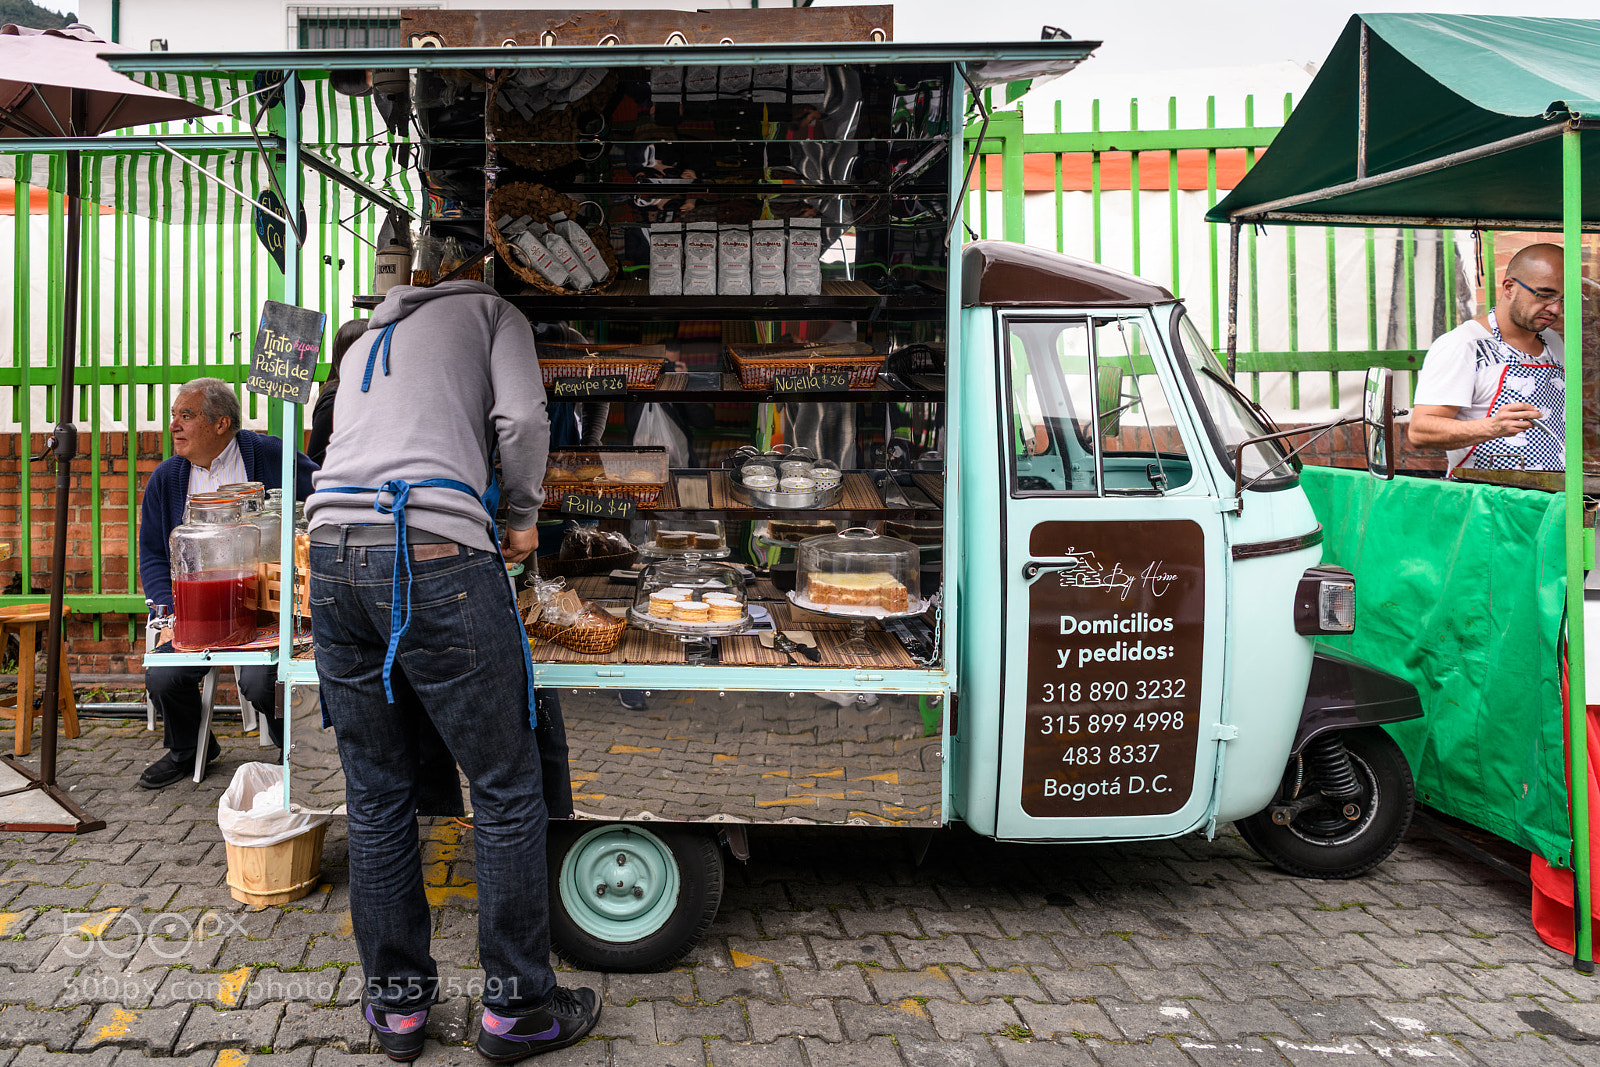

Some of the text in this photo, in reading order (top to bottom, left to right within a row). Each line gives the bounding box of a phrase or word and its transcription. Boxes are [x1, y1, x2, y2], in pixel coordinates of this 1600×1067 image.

[263, 329, 293, 353] Tinto
[255, 354, 309, 380] Pastel de
[246, 375, 300, 398] arequipe
[554, 380, 599, 396] Arequipe
[566, 495, 602, 514] Pollo
[1102, 560, 1179, 602] By Home
[1060, 612, 1174, 635] Domicilios
[1057, 641, 1175, 668] y pedidos:
[1042, 679, 1186, 703] 318 890 3232
[1041, 711, 1184, 735] 315 899 4998
[1062, 744, 1160, 766] 483 8337
[1044, 775, 1173, 801] Bogotá D.C.
[400, 1017, 418, 1029] NIKE
[484, 1014, 500, 1029] NIKE
